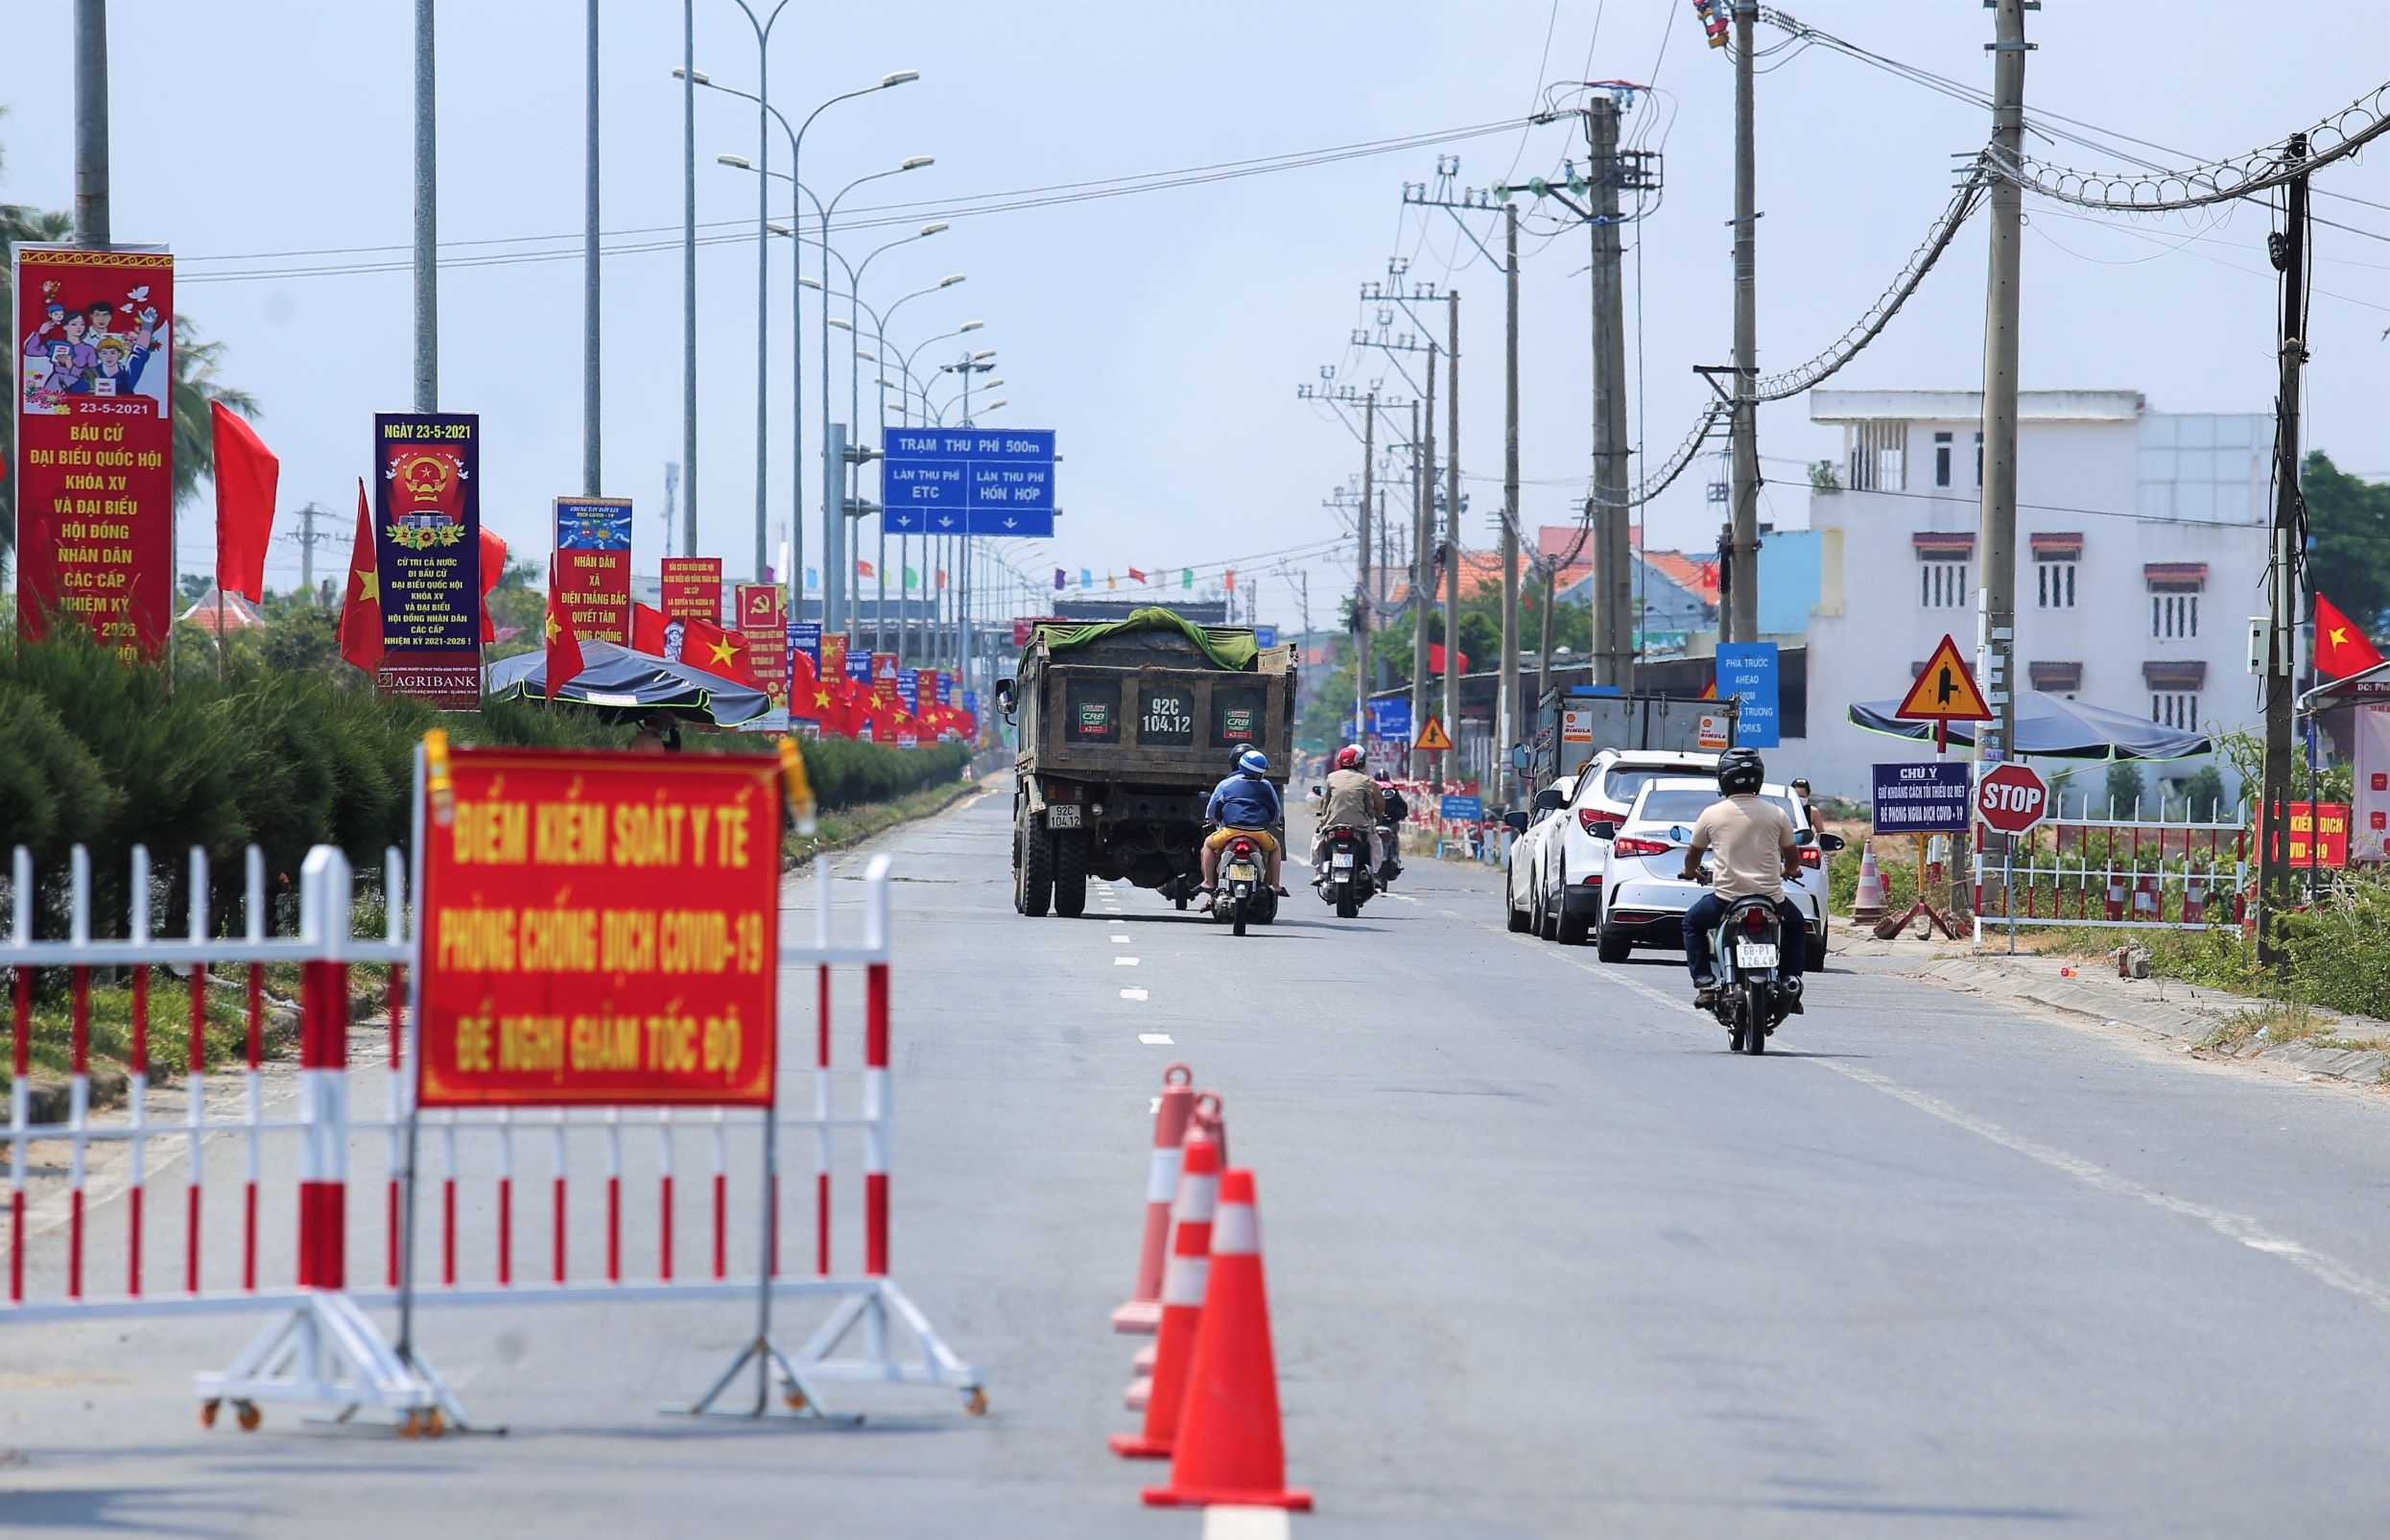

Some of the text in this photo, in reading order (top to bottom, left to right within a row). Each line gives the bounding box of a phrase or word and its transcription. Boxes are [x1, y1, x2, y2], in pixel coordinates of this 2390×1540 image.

[80, 403, 148, 414] 23-5-2021
[104, 423, 125, 441] CỬ
[385, 422, 470, 438] NGÀY 23-5-2021
[899, 438, 1039, 454] TRẠM THU PHÍ 500m
[30, 445, 162, 469] ĐẠI BIỂU QUỐC HỘI
[65, 473, 126, 490] KHÓA XV
[893, 468, 959, 481] LÀN THU PHÍ
[977, 472, 1044, 482] LÀN THU PHÍ
[912, 486, 939, 498] ETC
[1015, 486, 1040, 503] HỢP
[54, 495, 137, 517] VÀ ĐẠI BIỂU
[61, 522, 85, 541] HỘI
[58, 546, 132, 563] NHÂN DÂN
[437, 557, 458, 566] NƯỚC
[574, 555, 616, 568] NHÂN DÂN
[64, 569, 126, 587] CÁC CẤP
[391, 579, 462, 590] ĐẠI BIỂU QUỐC HỘI
[412, 591, 432, 600] KHÓA
[561, 590, 627, 606] ĐIỆN THẮNG BẮC
[60, 595, 130, 614] NHIỆM KỲ
[432, 602, 450, 610] BIỂU
[388, 614, 401, 624] HỘI
[427, 614, 449, 623] NHÂN
[451, 614, 467, 623] DÂN
[572, 608, 616, 624] QUYẾT TÂM
[428, 624, 444, 633] CẤP
[595, 628, 622, 642] CHỐNG
[384, 636, 410, 646] NHIỆM
[414, 636, 423, 645] KỲ
[1726, 655, 1768, 668] PHÍA TRƯỚC
[394, 676, 476, 687] AGRIBANK
[1736, 675, 1759, 684] AHEAD
[1152, 699, 1179, 715] 92C
[1744, 704, 1773, 717] TRƯỜNG
[1143, 716, 1191, 732] 104.12
[1900, 766, 1937, 779] CHÚ Ý
[1879, 785, 1887, 799] GIỮ
[1887, 783, 1908, 798] KHOẢNG
[1908, 783, 1923, 798] CÁCH
[1932, 781, 1946, 798] THIỂU
[1948, 786, 1953, 798] 02
[1954, 783, 1965, 797] MÉT
[1983, 783, 2042, 814] STOP
[1057, 806, 1073, 816] 92C
[1888, 803, 1906, 822] PHÒNG
[1924, 806, 1935, 825] DỊCH
[1936, 806, 1952, 821] COVID
[1956, 806, 1963, 821] 19
[454, 772, 753, 868] ĐIỂM KIỂM SOÁT Y TẾ
[2320, 817, 2343, 836] DỊCH
[2317, 843, 2328, 859] 19
[438, 885, 764, 987] PHÒNG CHỐNG DỊCH COVID-19
[1744, 946, 1769, 956] 68-P1
[499, 1015, 565, 1084] NGHỊ
[571, 1000, 640, 1072] GIẢM
[646, 996, 698, 1072] TỐC
[702, 1003, 742, 1083] ĐỘ
